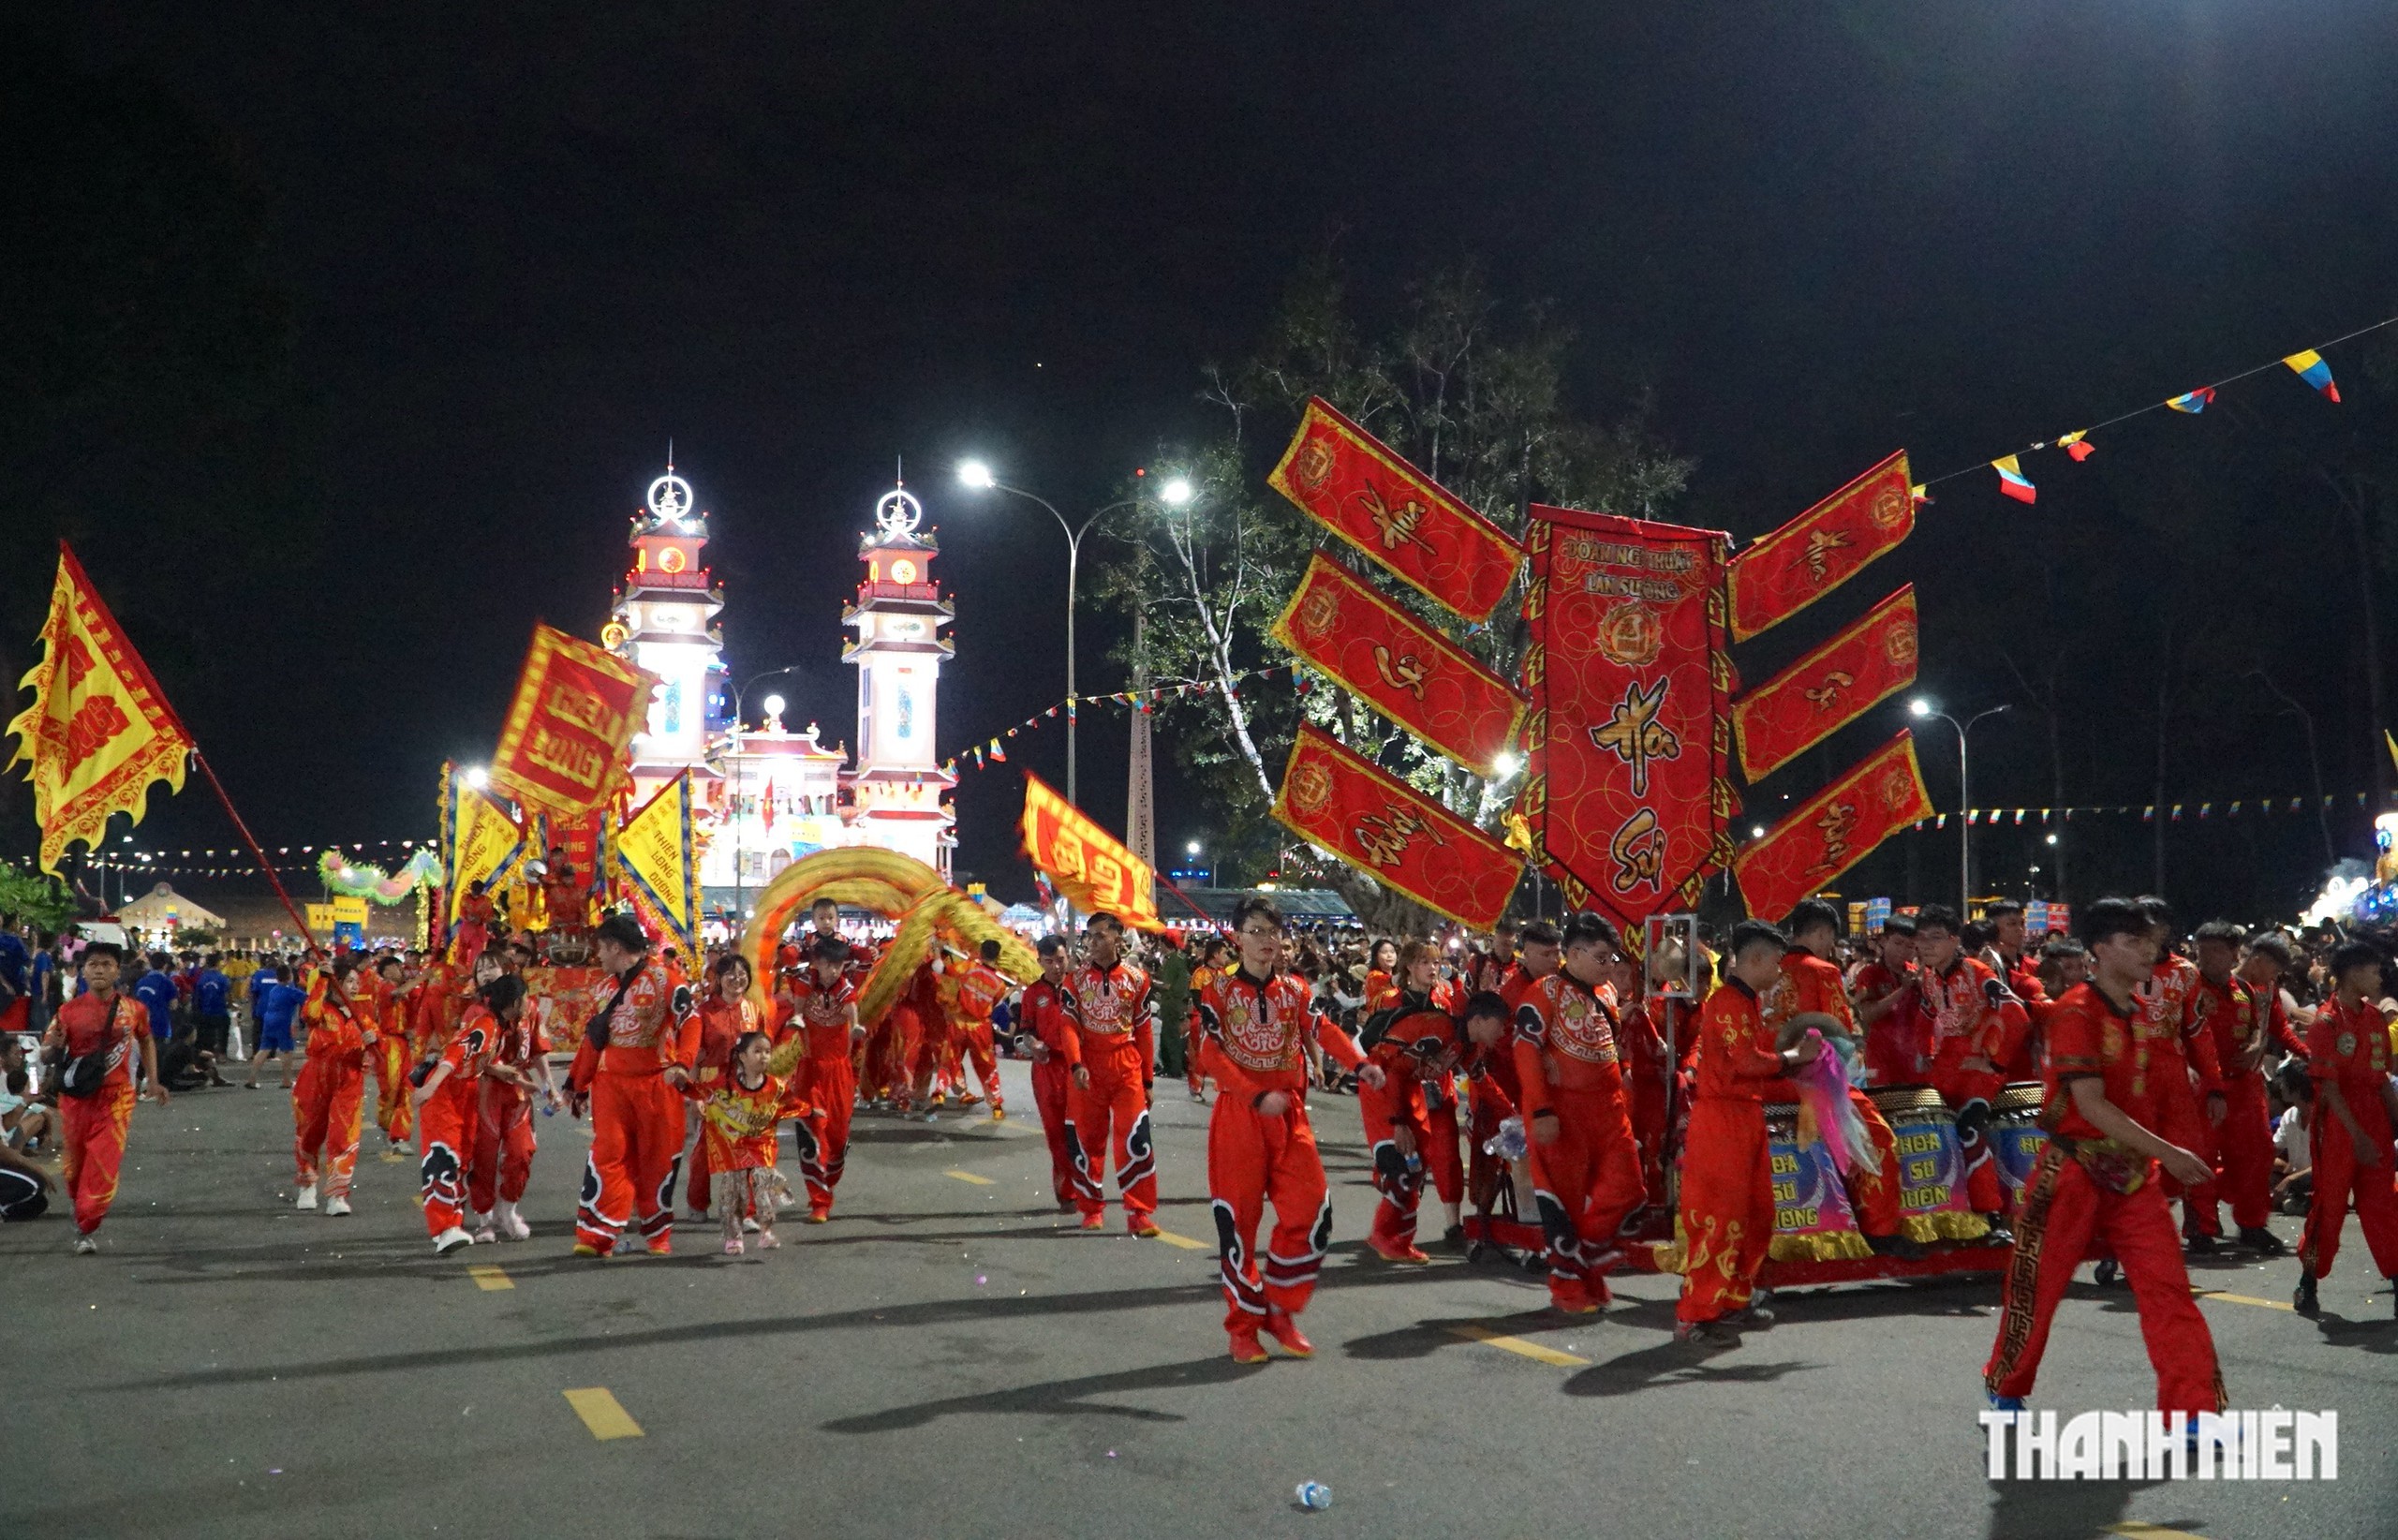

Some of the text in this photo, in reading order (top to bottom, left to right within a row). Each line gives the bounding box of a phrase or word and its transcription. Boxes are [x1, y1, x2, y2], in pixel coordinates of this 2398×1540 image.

[651, 850, 675, 879] LONG
[1900, 1133, 1942, 1154] HOA
[1769, 1153, 1800, 1175] OA
